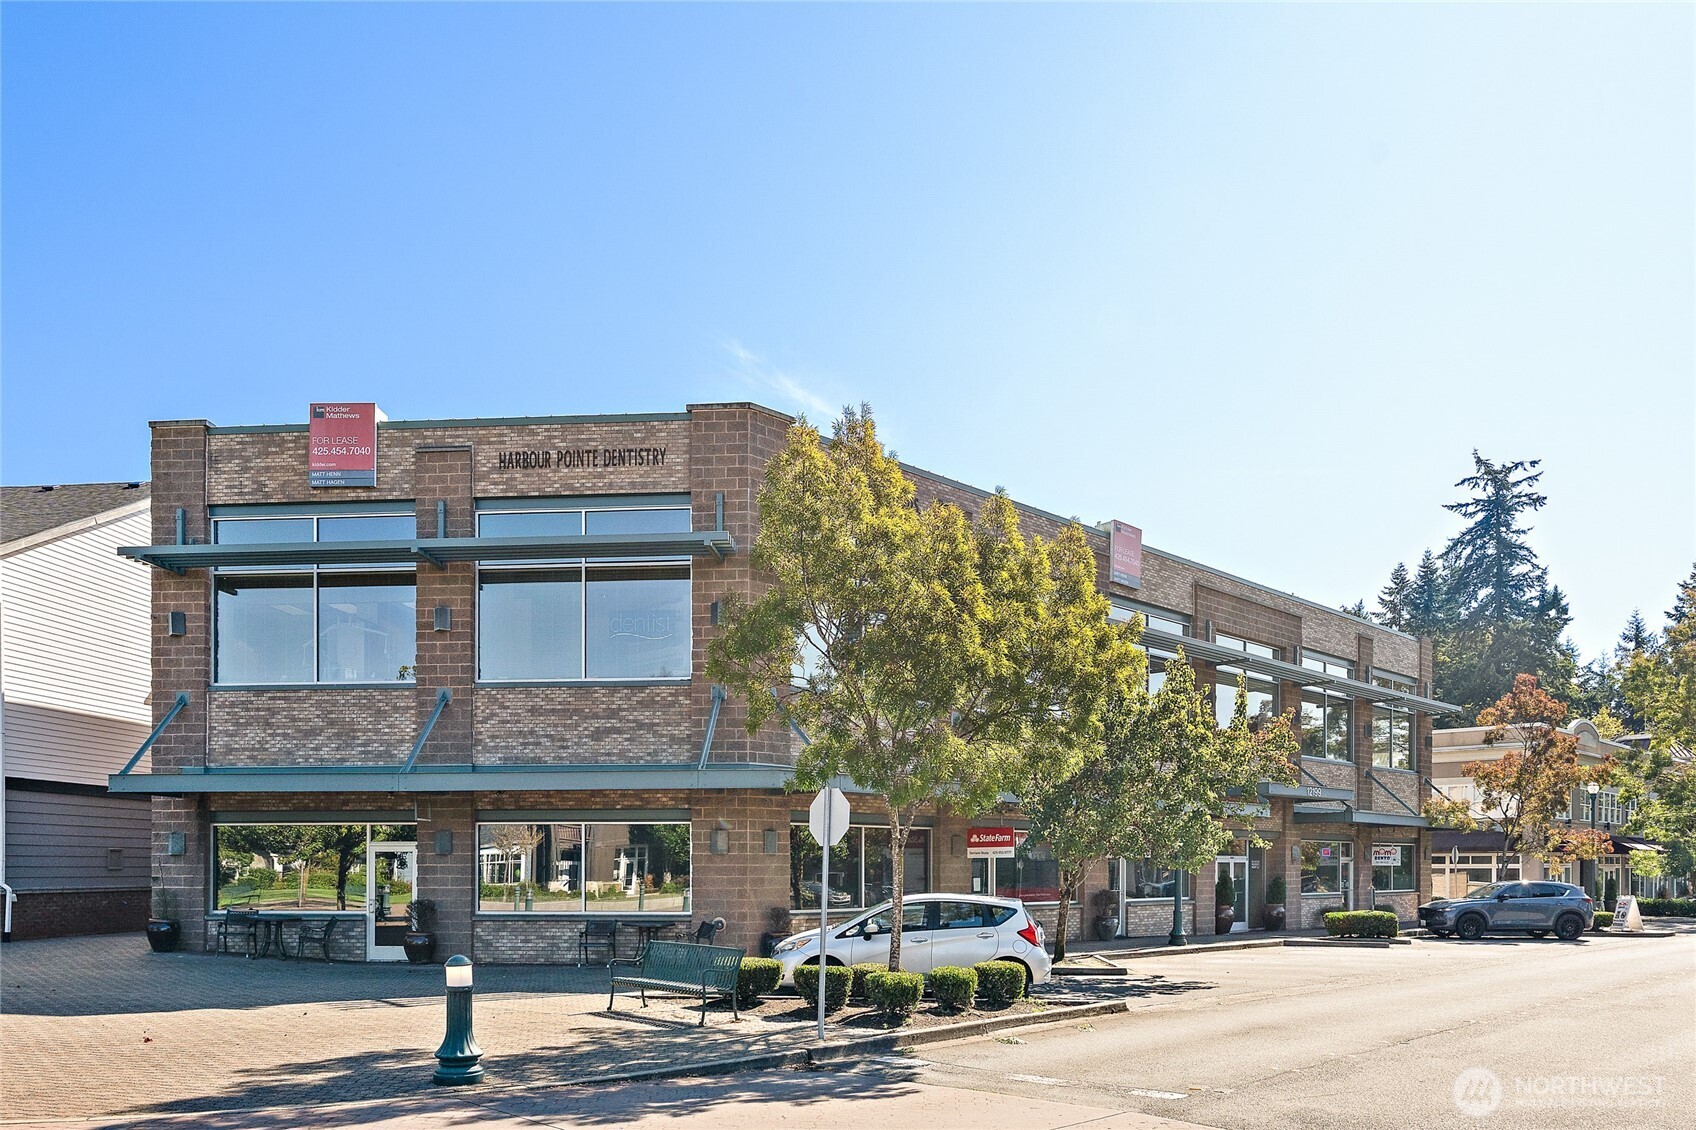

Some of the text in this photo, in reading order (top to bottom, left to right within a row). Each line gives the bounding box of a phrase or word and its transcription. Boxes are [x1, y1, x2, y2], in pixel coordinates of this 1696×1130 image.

[312, 437, 358, 445] FOR LEASE
[312, 446, 371, 455] 425.454.7040
[499, 447, 667, 469] HARBOUR POINTE DENTISTRY
[610, 613, 671, 633] dentist
[1307, 787, 1321, 797] 12199
